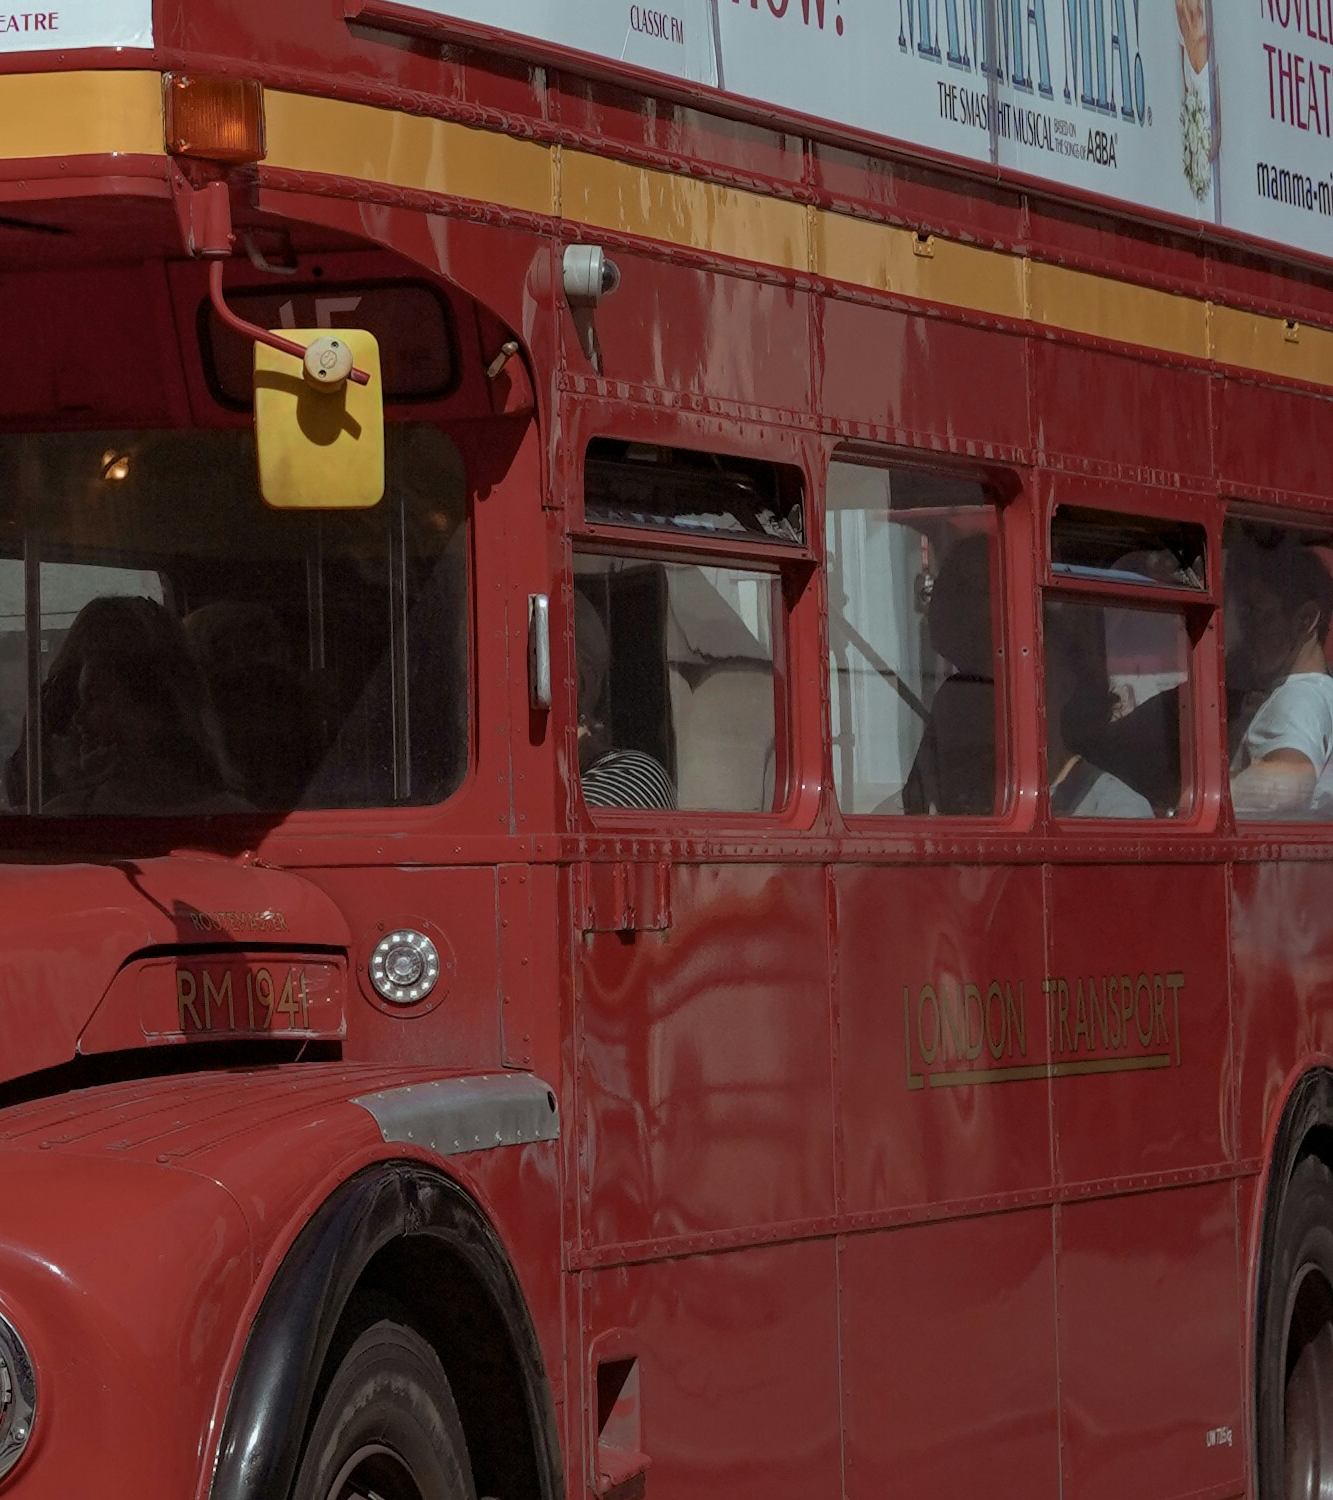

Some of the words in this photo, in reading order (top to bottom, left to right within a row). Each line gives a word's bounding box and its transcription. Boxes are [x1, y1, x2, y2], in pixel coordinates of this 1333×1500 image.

[630, 4, 669, 41] CLASSIC
[670, 16, 684, 45] FM
[936, 81, 958, 122] THE
[997, 99, 1012, 139] HIT
[1013, 105, 1055, 152] MUSICAL
[1086, 127, 1118, 169] ABBA
[190, 909, 290, 932] ROUTEMASTER
[176, 967, 235, 1031] RM
[246, 966, 310, 1030] 1941
[903, 979, 1028, 1091] LONDON
[1041, 971, 1185, 1067] TRANSPORT
